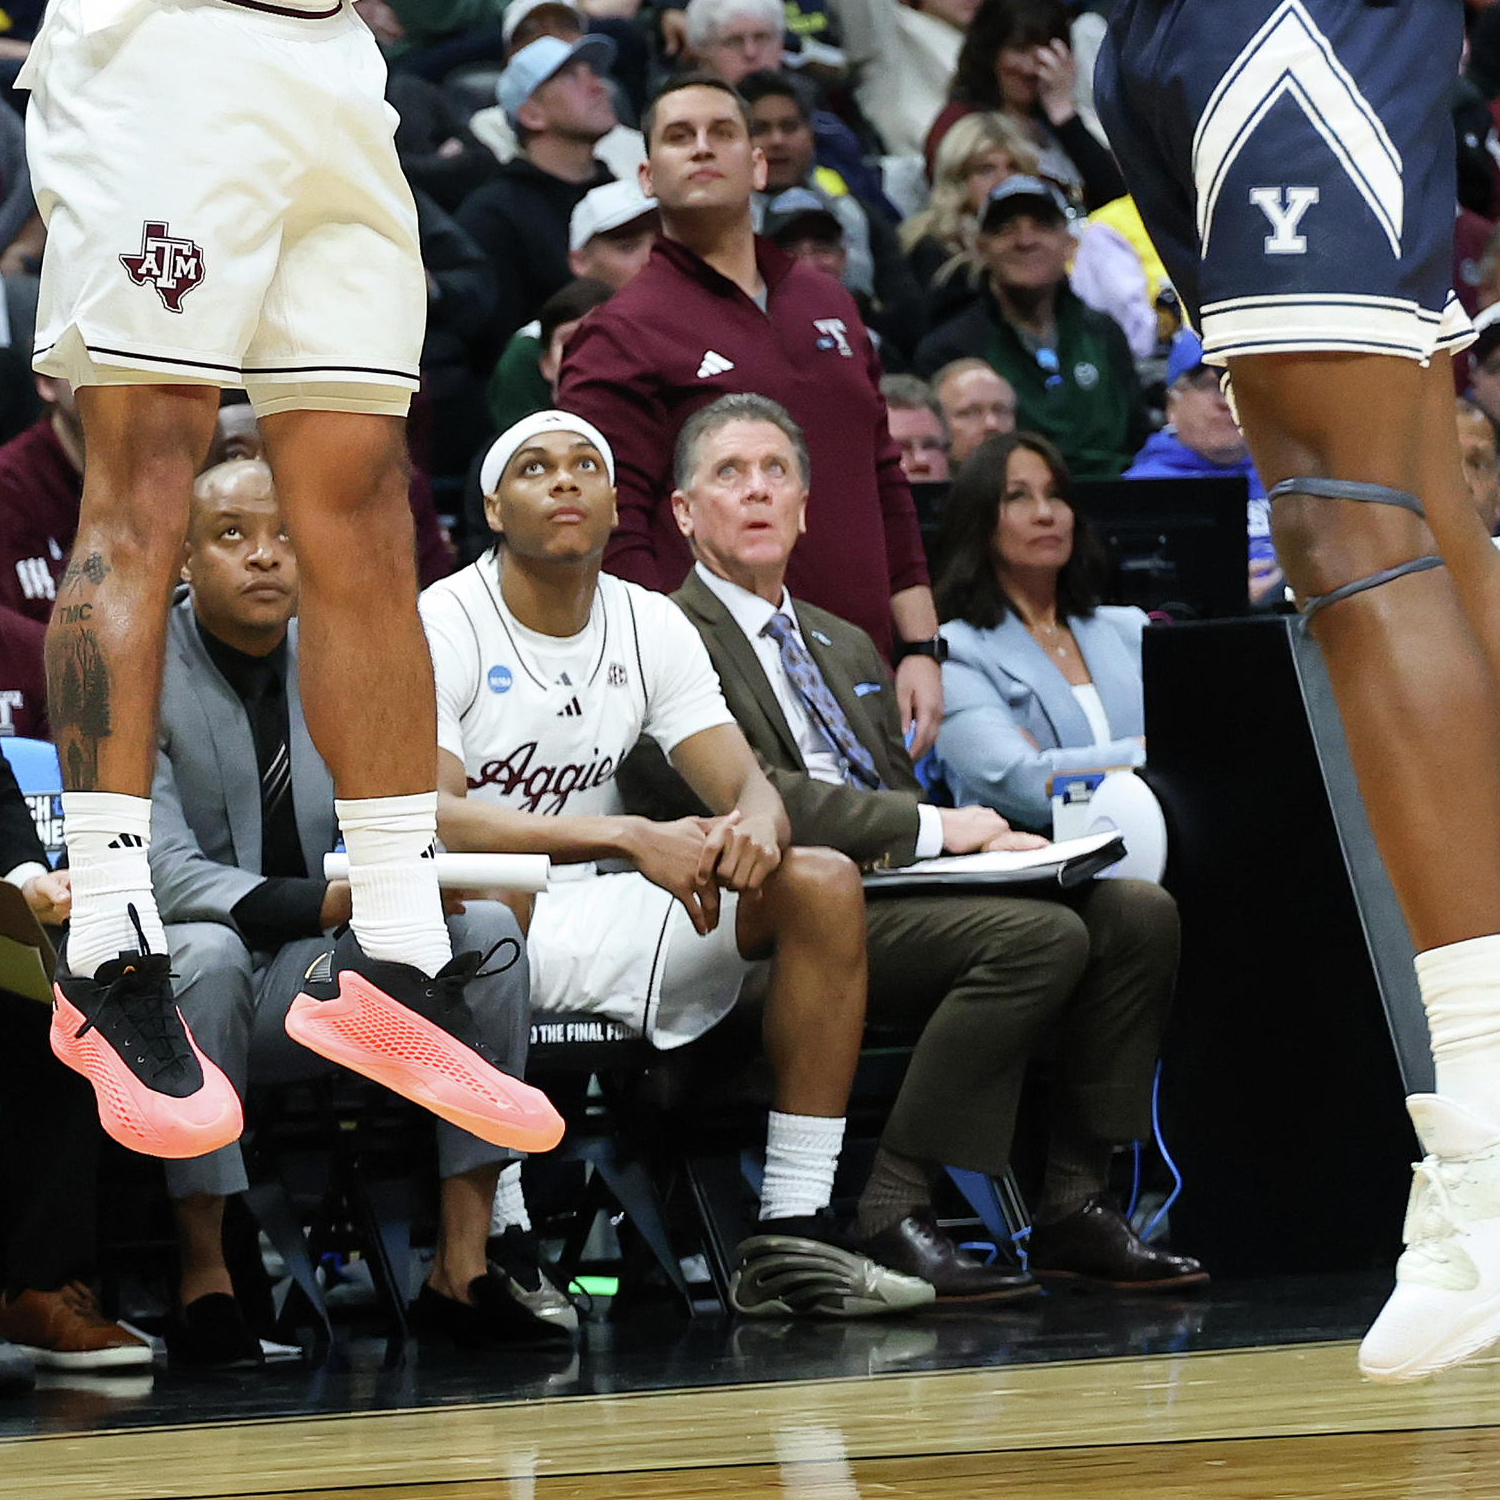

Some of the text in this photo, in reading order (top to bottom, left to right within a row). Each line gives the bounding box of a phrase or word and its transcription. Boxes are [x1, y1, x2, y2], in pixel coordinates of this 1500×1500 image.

[1249, 187, 1320, 254] Y
[60, 602, 94, 626] TMC
[539, 1023, 565, 1044] THE
[566, 1022, 605, 1042] FINAL
